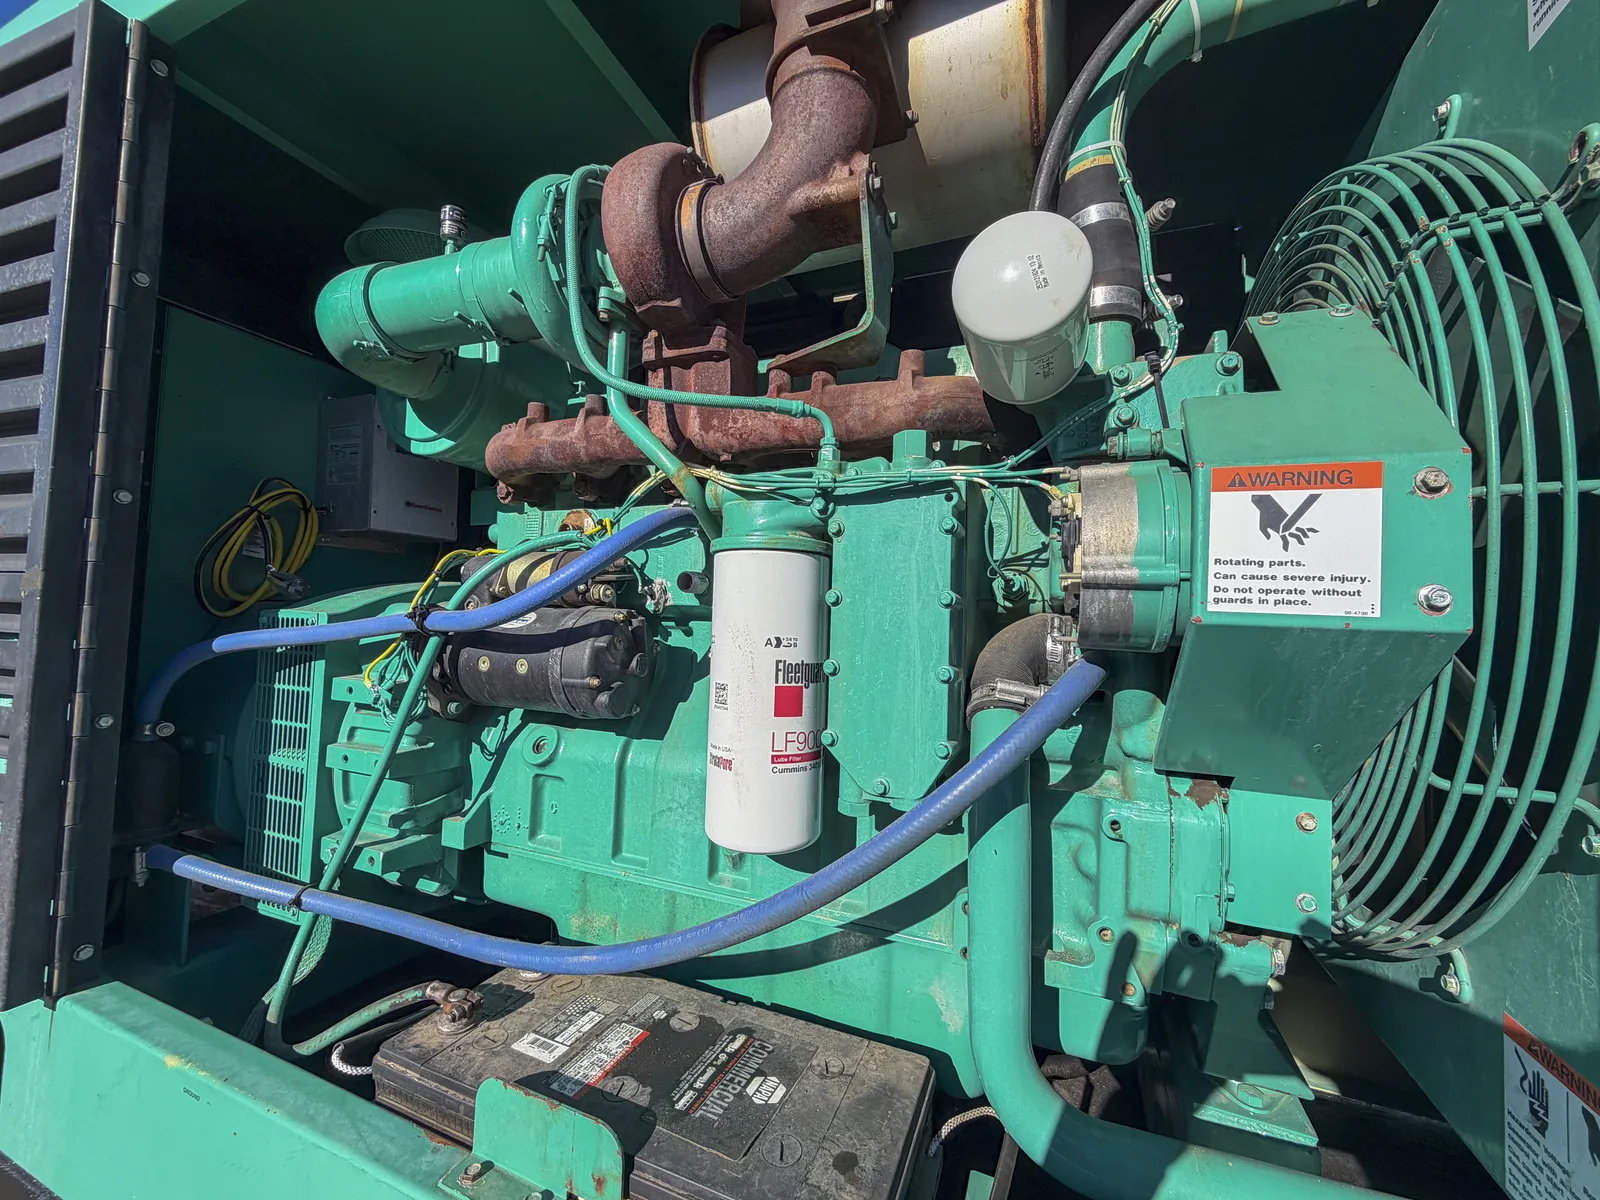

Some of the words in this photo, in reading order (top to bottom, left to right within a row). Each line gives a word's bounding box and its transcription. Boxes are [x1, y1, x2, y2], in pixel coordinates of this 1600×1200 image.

[1248, 470, 1354, 487] WARNING
[1214, 558, 1264, 568] Rotating
[1268, 558, 1306, 568] parts.
[1214, 572, 1236, 581] Can
[1241, 574, 1278, 582] cause
[1283, 574, 1325, 582] severe
[1330, 574, 1372, 586] injury.
[1214, 586, 1229, 594] Do
[1234, 586, 1253, 594] not
[1258, 586, 1306, 597] operate
[1312, 588, 1362, 597] without
[1212, 596, 1254, 606] guards
[1258, 596, 1269, 605] in
[1274, 596, 1312, 608] place.
[774, 660, 824, 689] Fleetguar
[772, 728, 824, 752] LF900
[772, 765, 808, 774] Cummins
[695, 1040, 773, 1120] COMMERCIAL
[753, 1077, 777, 1102] NAPA
